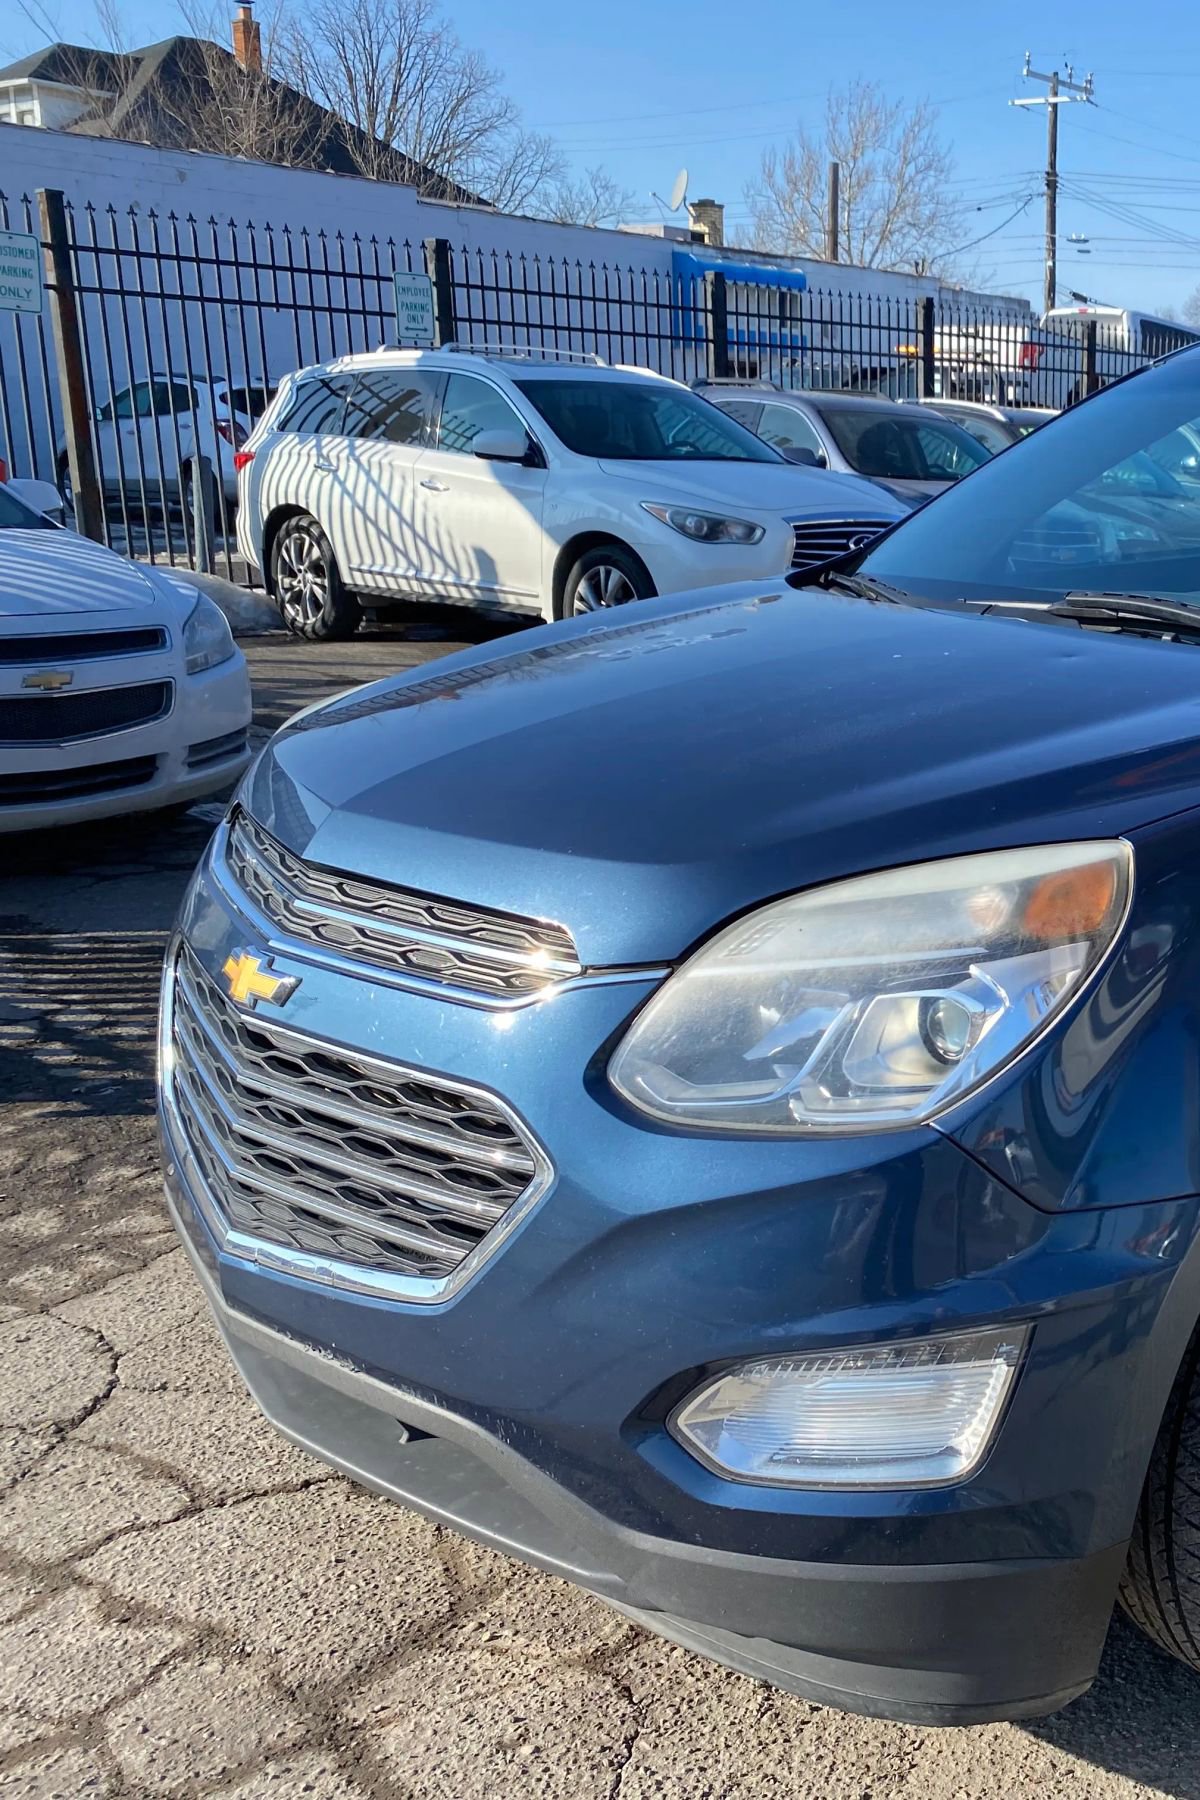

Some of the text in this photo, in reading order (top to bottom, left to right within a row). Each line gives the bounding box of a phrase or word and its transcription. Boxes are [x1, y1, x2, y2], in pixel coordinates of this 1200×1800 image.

[0, 265, 33, 279] ARKING
[0, 285, 32, 299] ONLY
[397, 286, 430, 298] EMPLOYEE
[400, 301, 430, 313] PARKING
[406, 313, 425, 325] ONLY
